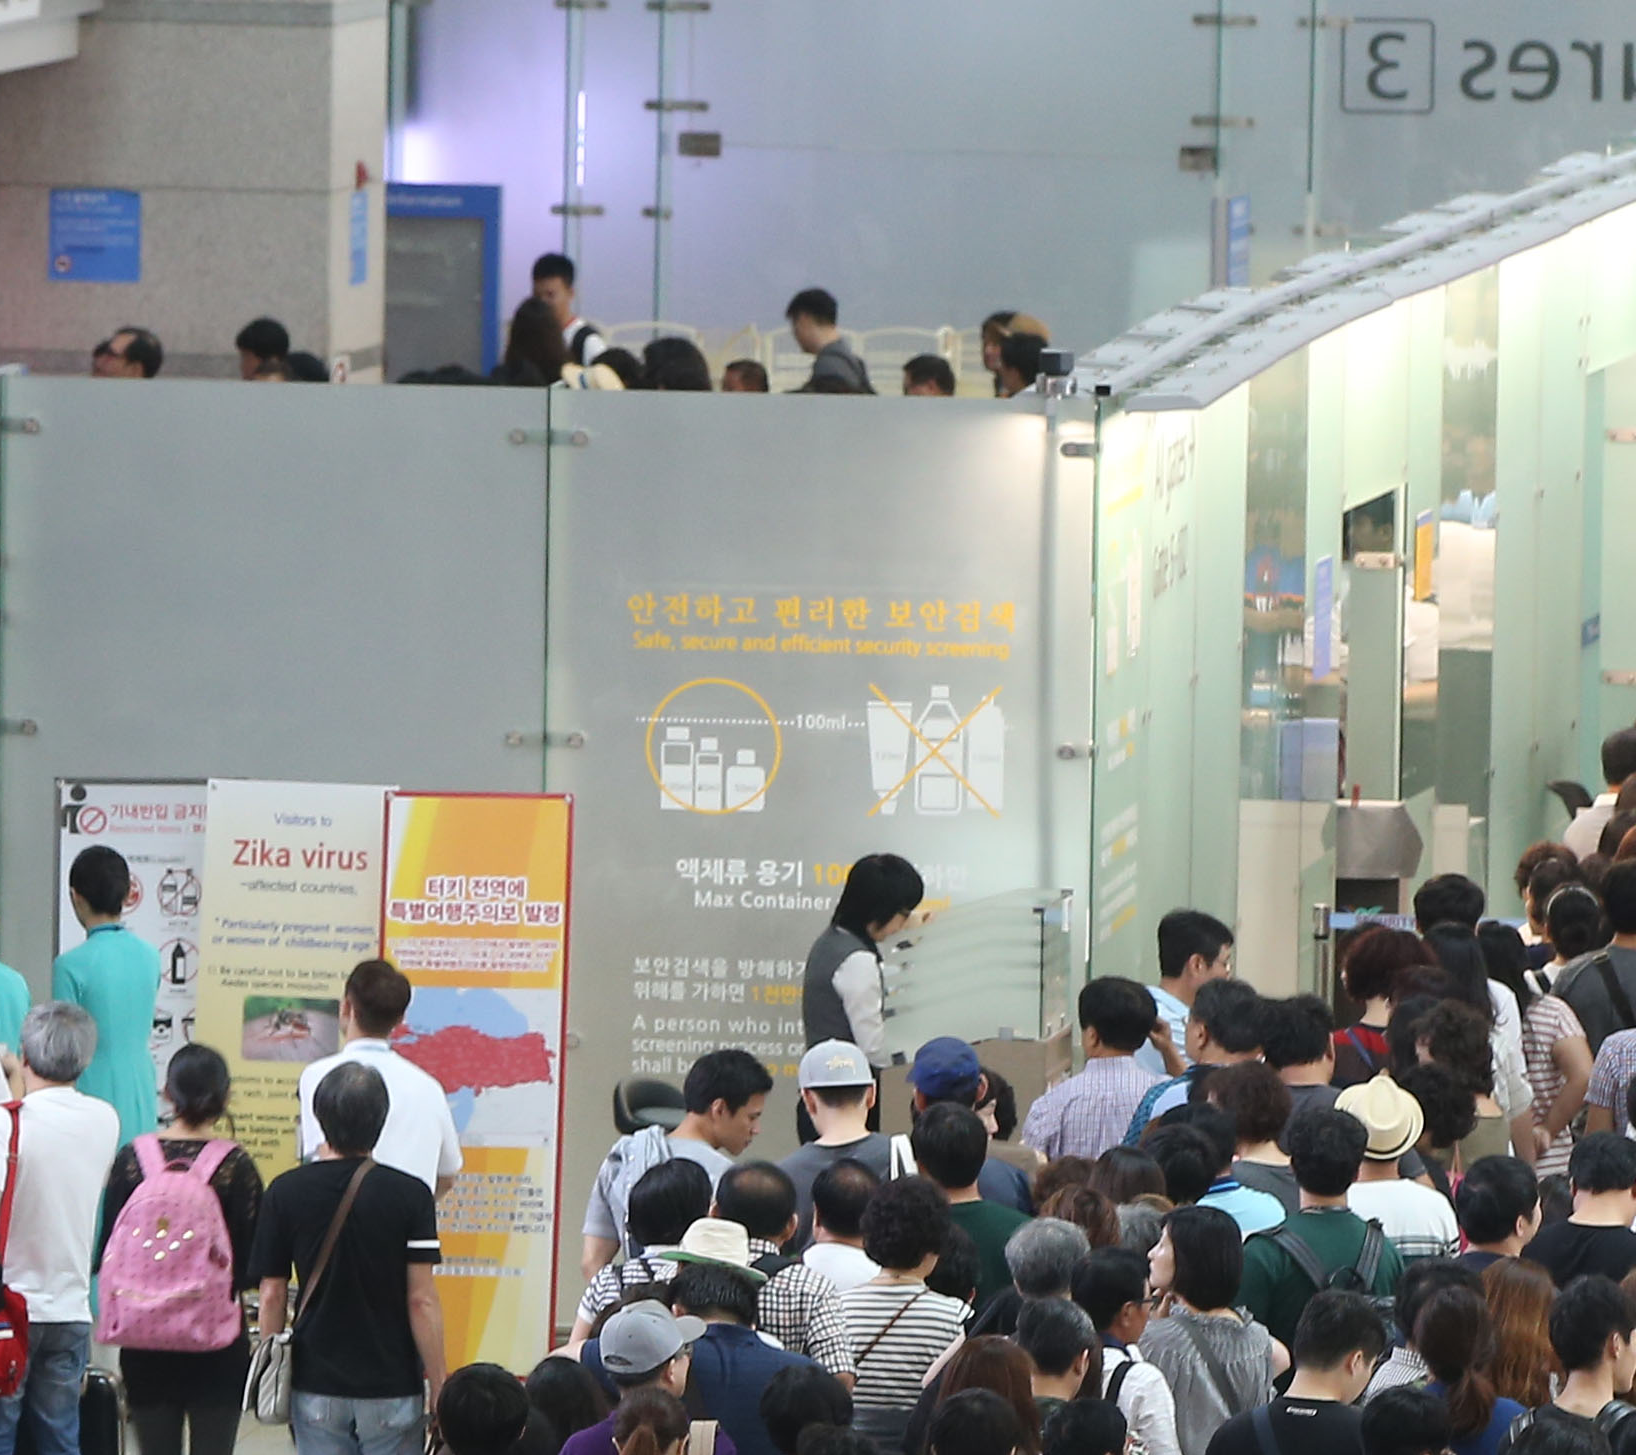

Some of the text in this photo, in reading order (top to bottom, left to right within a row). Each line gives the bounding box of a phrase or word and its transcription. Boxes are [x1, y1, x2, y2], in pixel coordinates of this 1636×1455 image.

[627, 592, 1016, 634] 안전하고 편리한 보안검색
[633, 630, 1011, 661] Safe, secure and efficient security screening
[796, 714, 846, 731] 100ml
[111, 803, 168, 820] 기내반입
[274, 813, 332, 827] Visitors to
[233, 839, 368, 870] Zika virus
[676, 858, 749, 887] 액체류
[755, 860, 803, 888] 용기
[427, 878, 525, 898] 터키 전역에
[695, 890, 833, 912] Max Container
[391, 902, 518, 923] 특별여행주의보
[633, 956, 728, 979] 보안검색을
[633, 981, 687, 1001] 위해를
[692, 984, 746, 1004] 가하면
[633, 1014, 646, 1032] A
[654, 1017, 720, 1037] person
[729, 1015, 770, 1036] who
[633, 1038, 714, 1055] screening
[632, 1056, 674, 1074] shall
